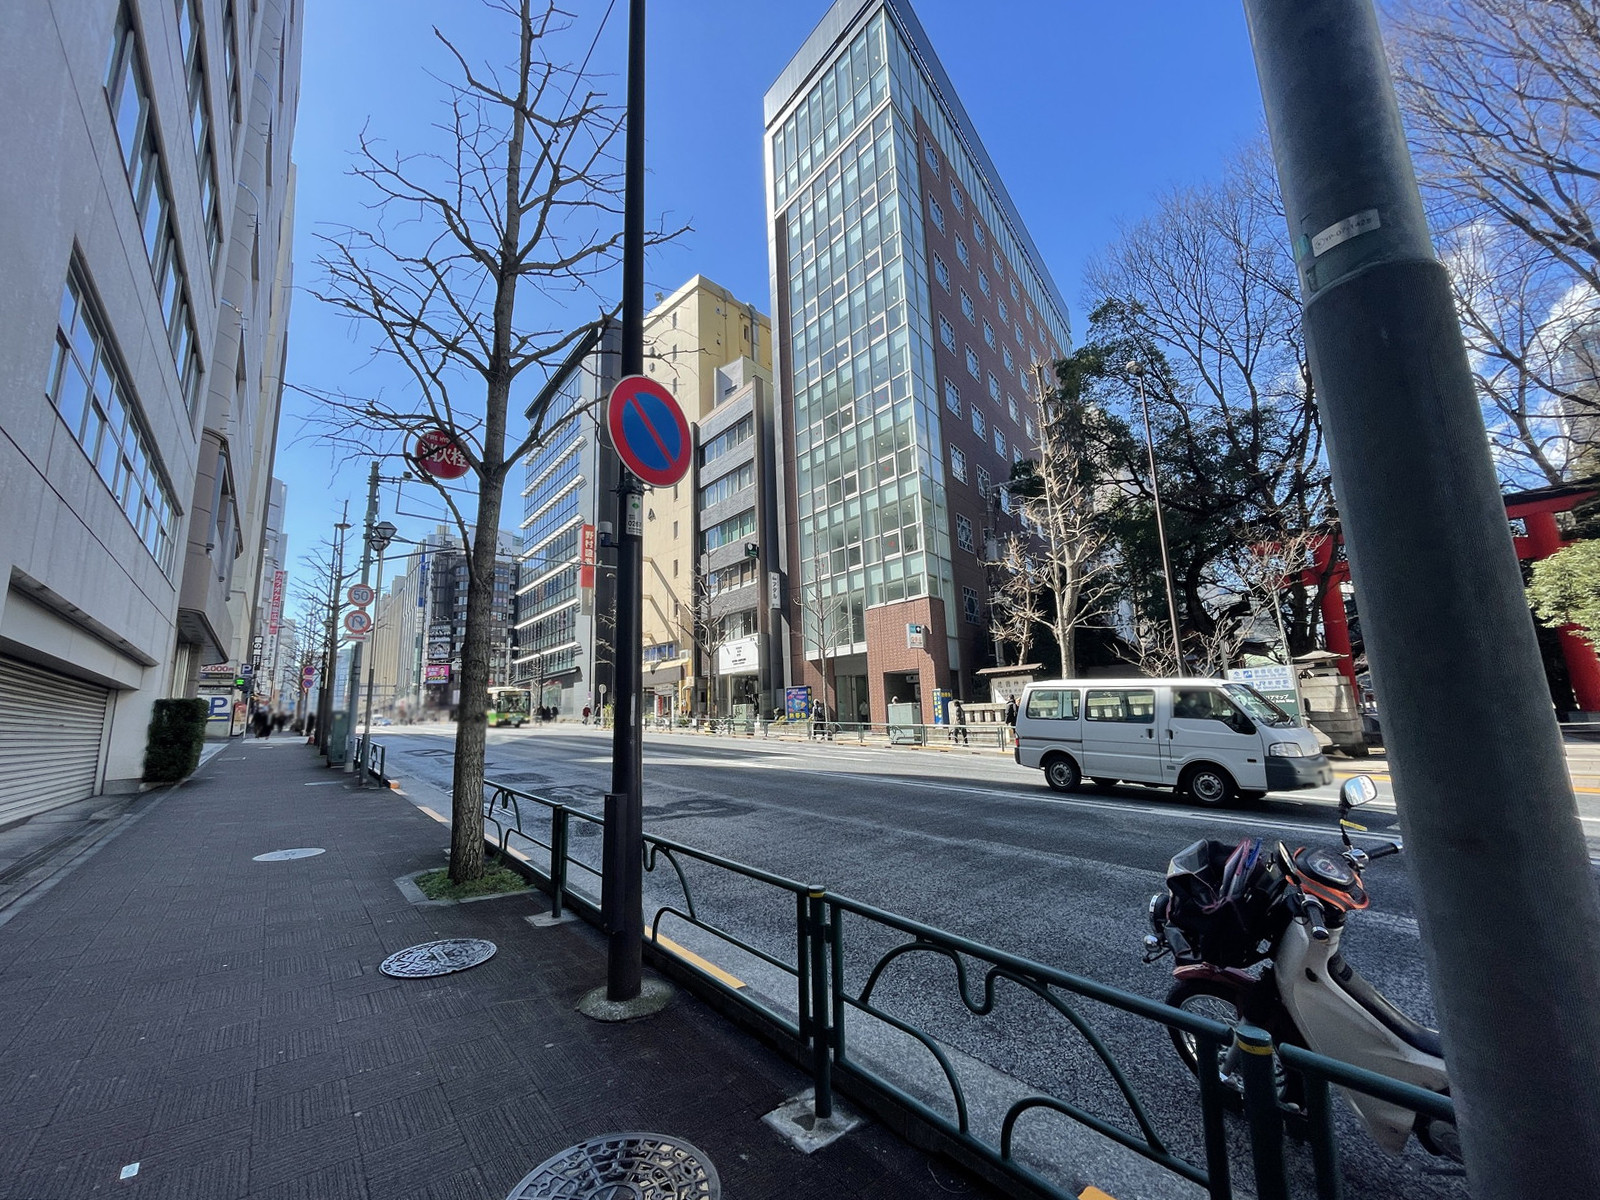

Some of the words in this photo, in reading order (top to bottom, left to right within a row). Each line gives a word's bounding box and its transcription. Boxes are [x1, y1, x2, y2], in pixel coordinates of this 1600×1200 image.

[353, 590, 369, 601] 50
[242, 665, 252, 674] P
[209, 697, 228, 715] P
